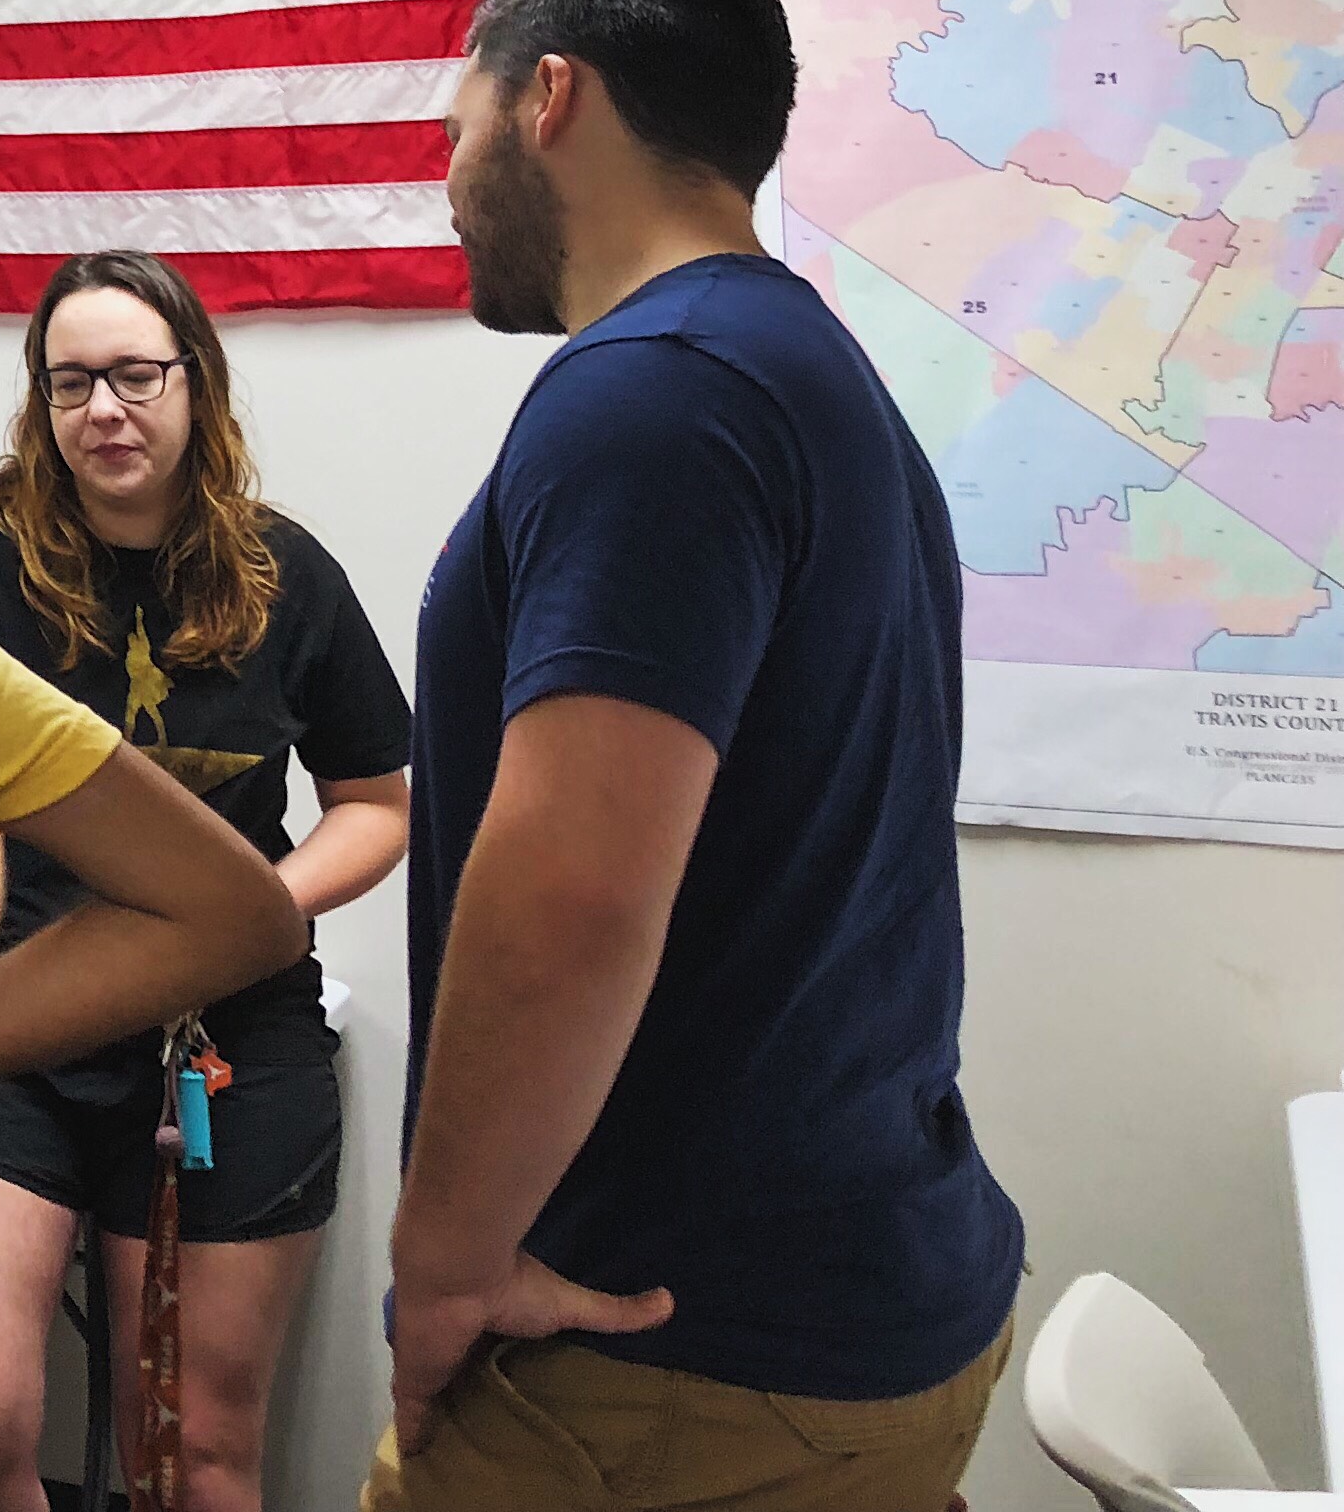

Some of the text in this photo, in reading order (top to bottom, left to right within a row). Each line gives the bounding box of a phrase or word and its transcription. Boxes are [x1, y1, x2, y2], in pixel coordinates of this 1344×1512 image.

[1094, 72, 1118, 86] 21
[962, 300, 987, 315] 25
[1212, 691, 1338, 712] DISTRICT 21
[1194, 710, 1268, 728] TRAVIS
